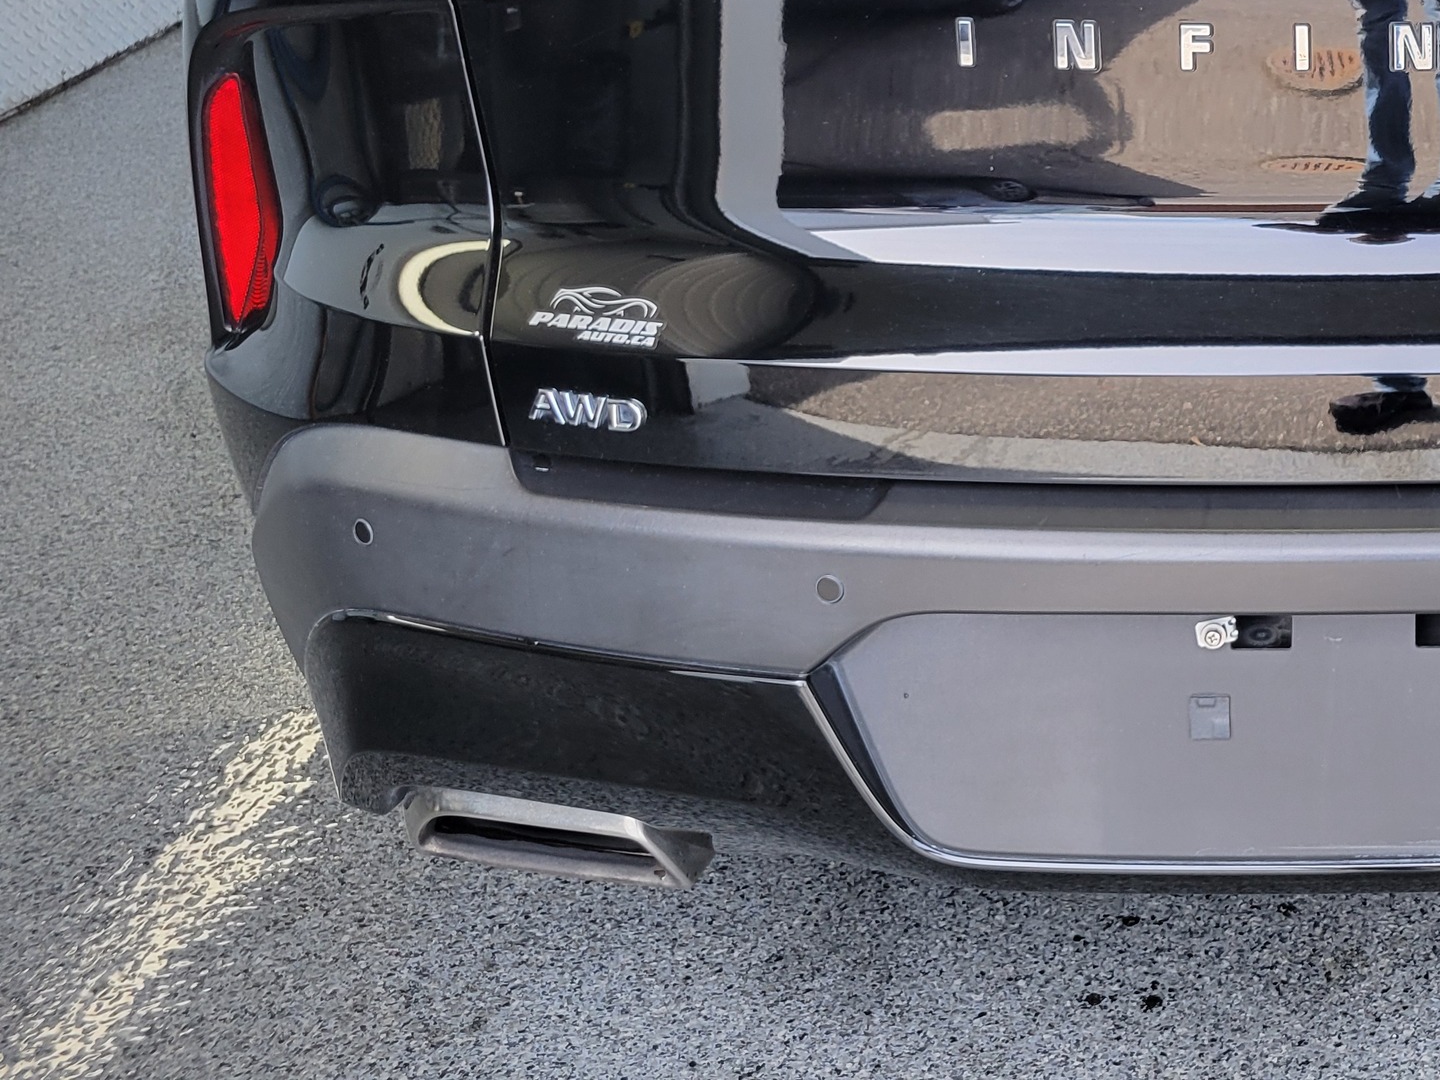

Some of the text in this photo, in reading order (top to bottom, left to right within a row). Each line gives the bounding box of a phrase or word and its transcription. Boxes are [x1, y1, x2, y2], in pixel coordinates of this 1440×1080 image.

[528, 311, 663, 336] PARADIS
[577, 331, 656, 347] AUTO.CA
[528, 388, 648, 432] AWD
